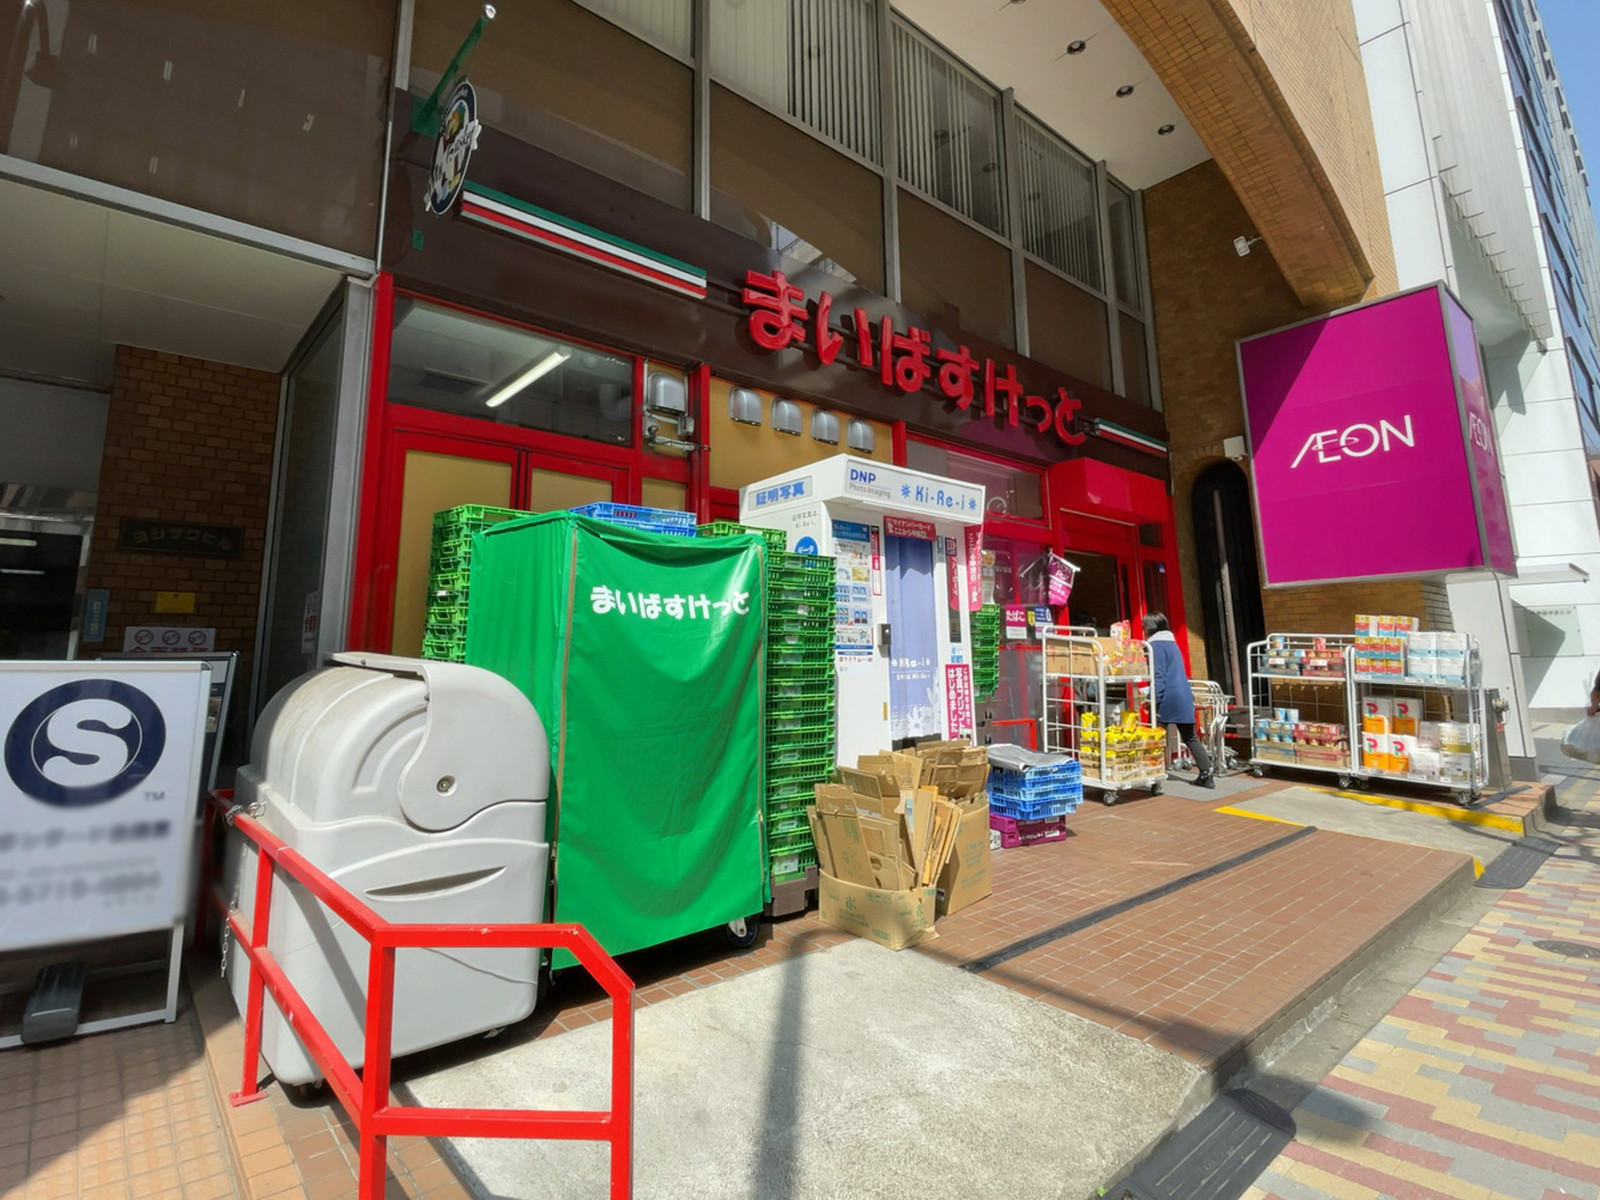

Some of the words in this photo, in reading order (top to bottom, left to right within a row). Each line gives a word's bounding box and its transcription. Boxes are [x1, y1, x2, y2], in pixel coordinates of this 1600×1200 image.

[742, 270, 1087, 446] まいばすけっと
[849, 482, 866, 493] Photo
[866, 486, 891, 499] Imaging
[850, 469, 876, 484] DNP
[755, 481, 805, 506] 証明写真
[590, 584, 750, 620] まいばすけっと
[1005, 609, 1026, 622] たばこ
[947, 668, 958, 733] はじめました
[955, 667, 965, 733] 写真プリント
